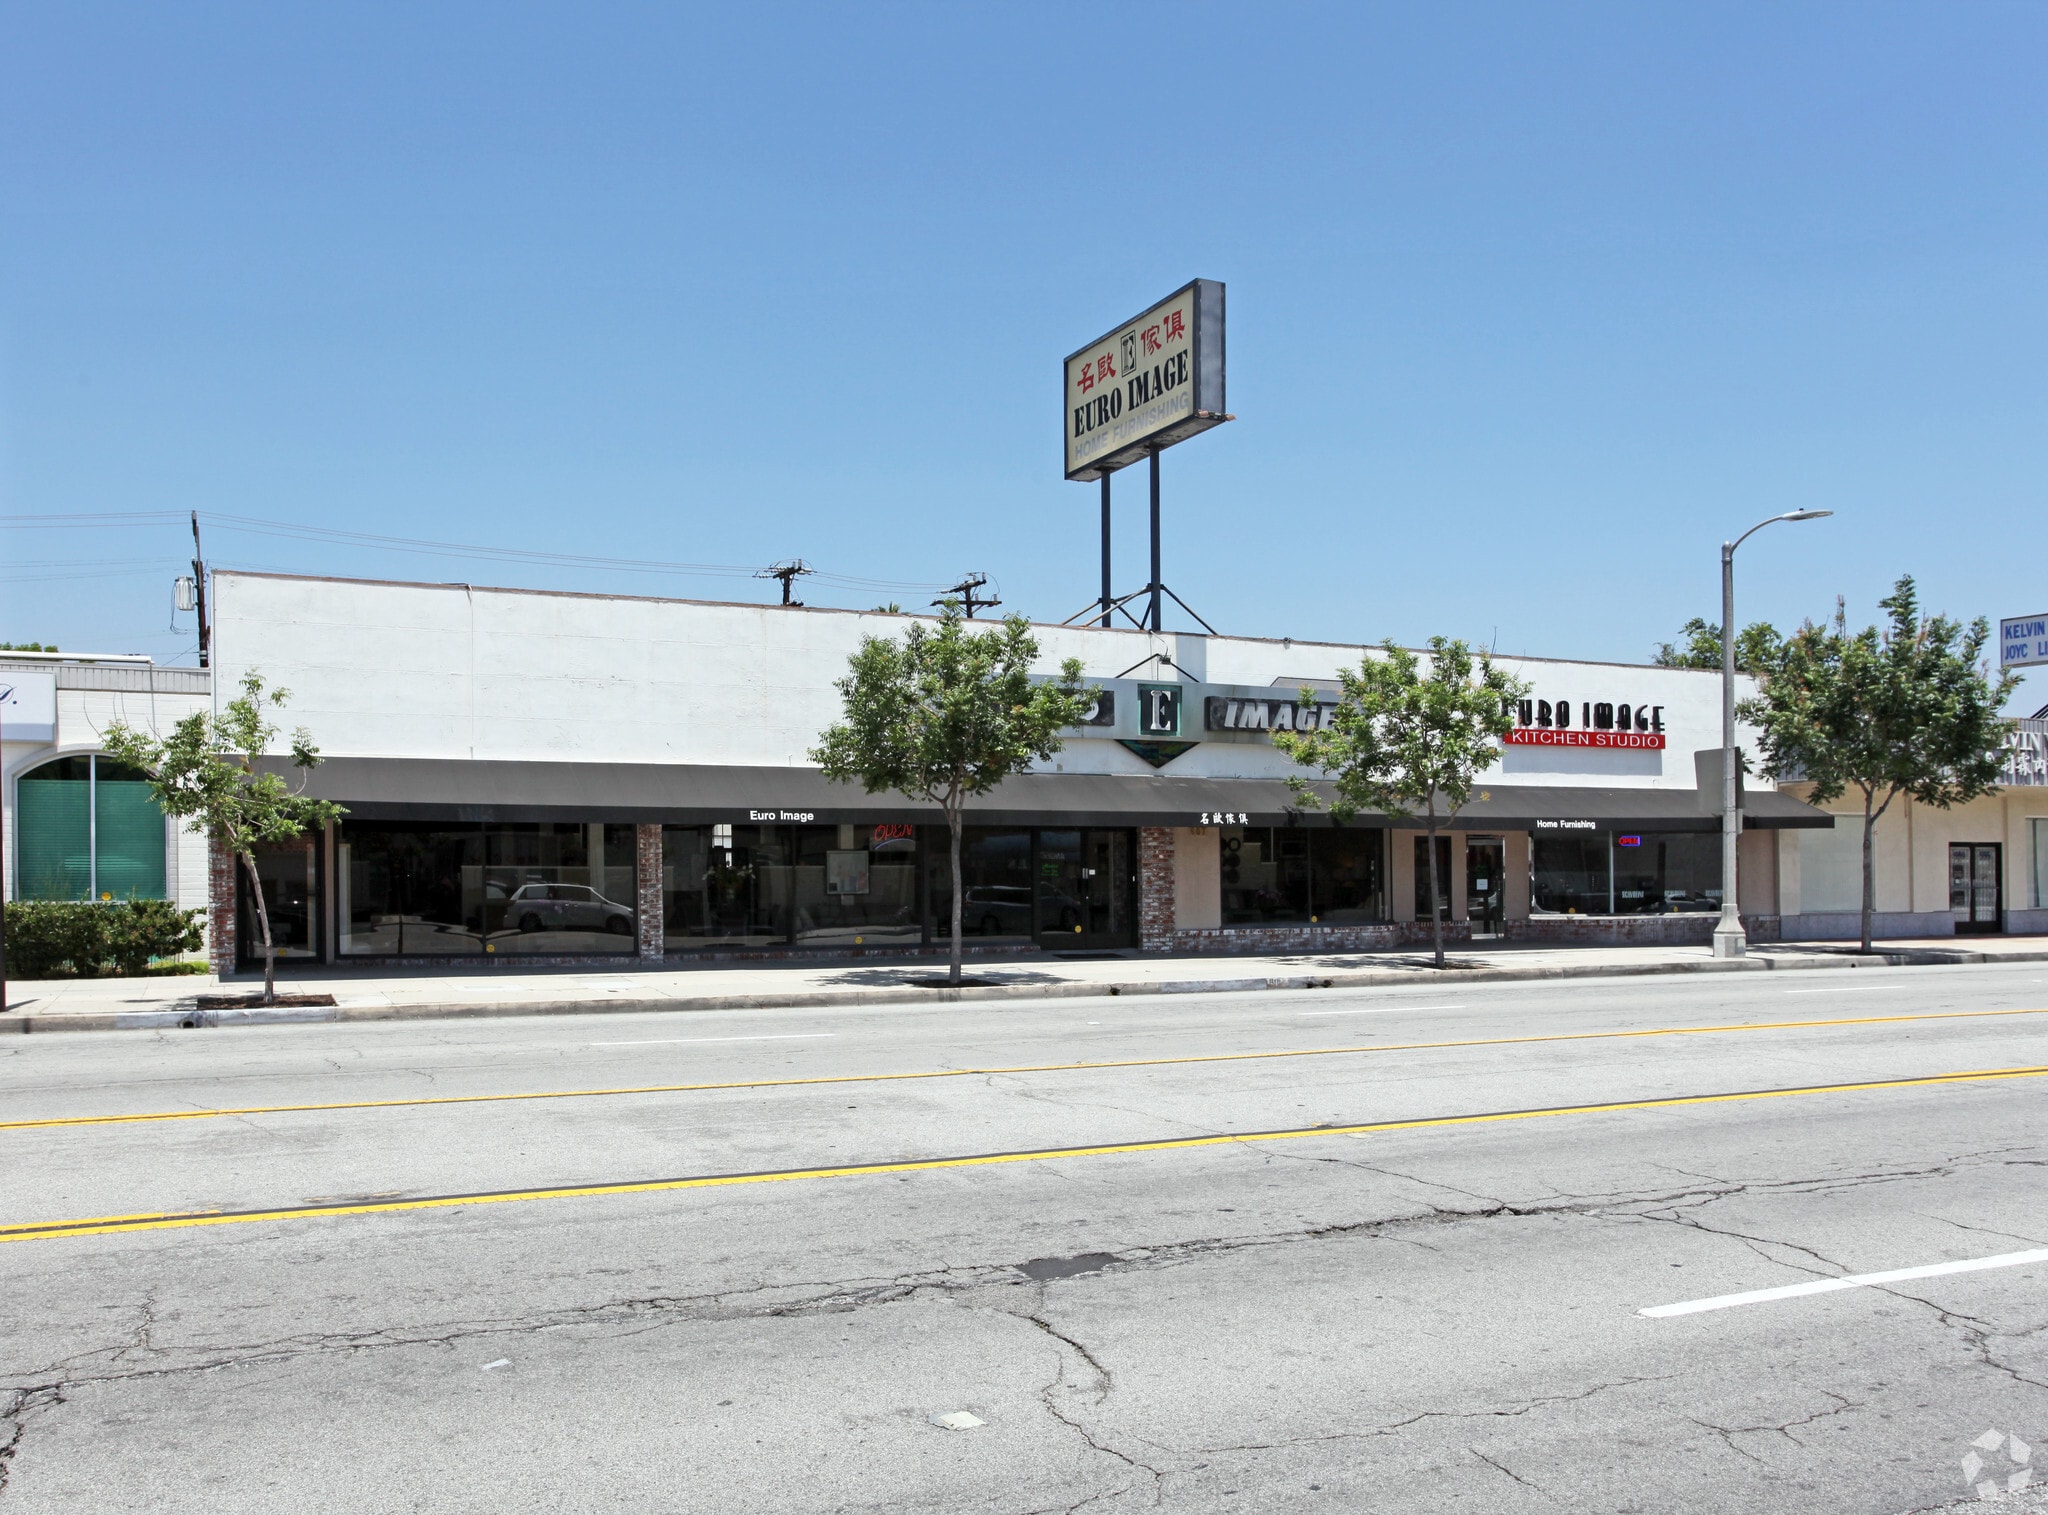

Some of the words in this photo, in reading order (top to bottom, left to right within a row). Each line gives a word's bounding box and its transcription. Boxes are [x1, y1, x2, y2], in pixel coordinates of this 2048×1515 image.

[1073, 387, 1122, 437] EURO
[1127, 349, 1188, 412] IMAGE
[1075, 431, 1108, 460] HOME
[1112, 391, 1189, 444] FURNISHING
[2005, 621, 2045, 640] KELVIN
[2005, 643, 2028, 660] JOYC
[1150, 690, 1171, 731] E
[1224, 701, 1338, 731] IMAGE
[1582, 702, 1665, 731] IMAGE
[1512, 731, 1589, 745] KITCHEN
[1596, 734, 1659, 748] STUDIO
[750, 810, 776, 820] Euro
[780, 810, 814, 823] Image
[1537, 819, 1558, 828] Home
[1560, 820, 1596, 830] Furnishing
[874, 823, 913, 841] OPEN
